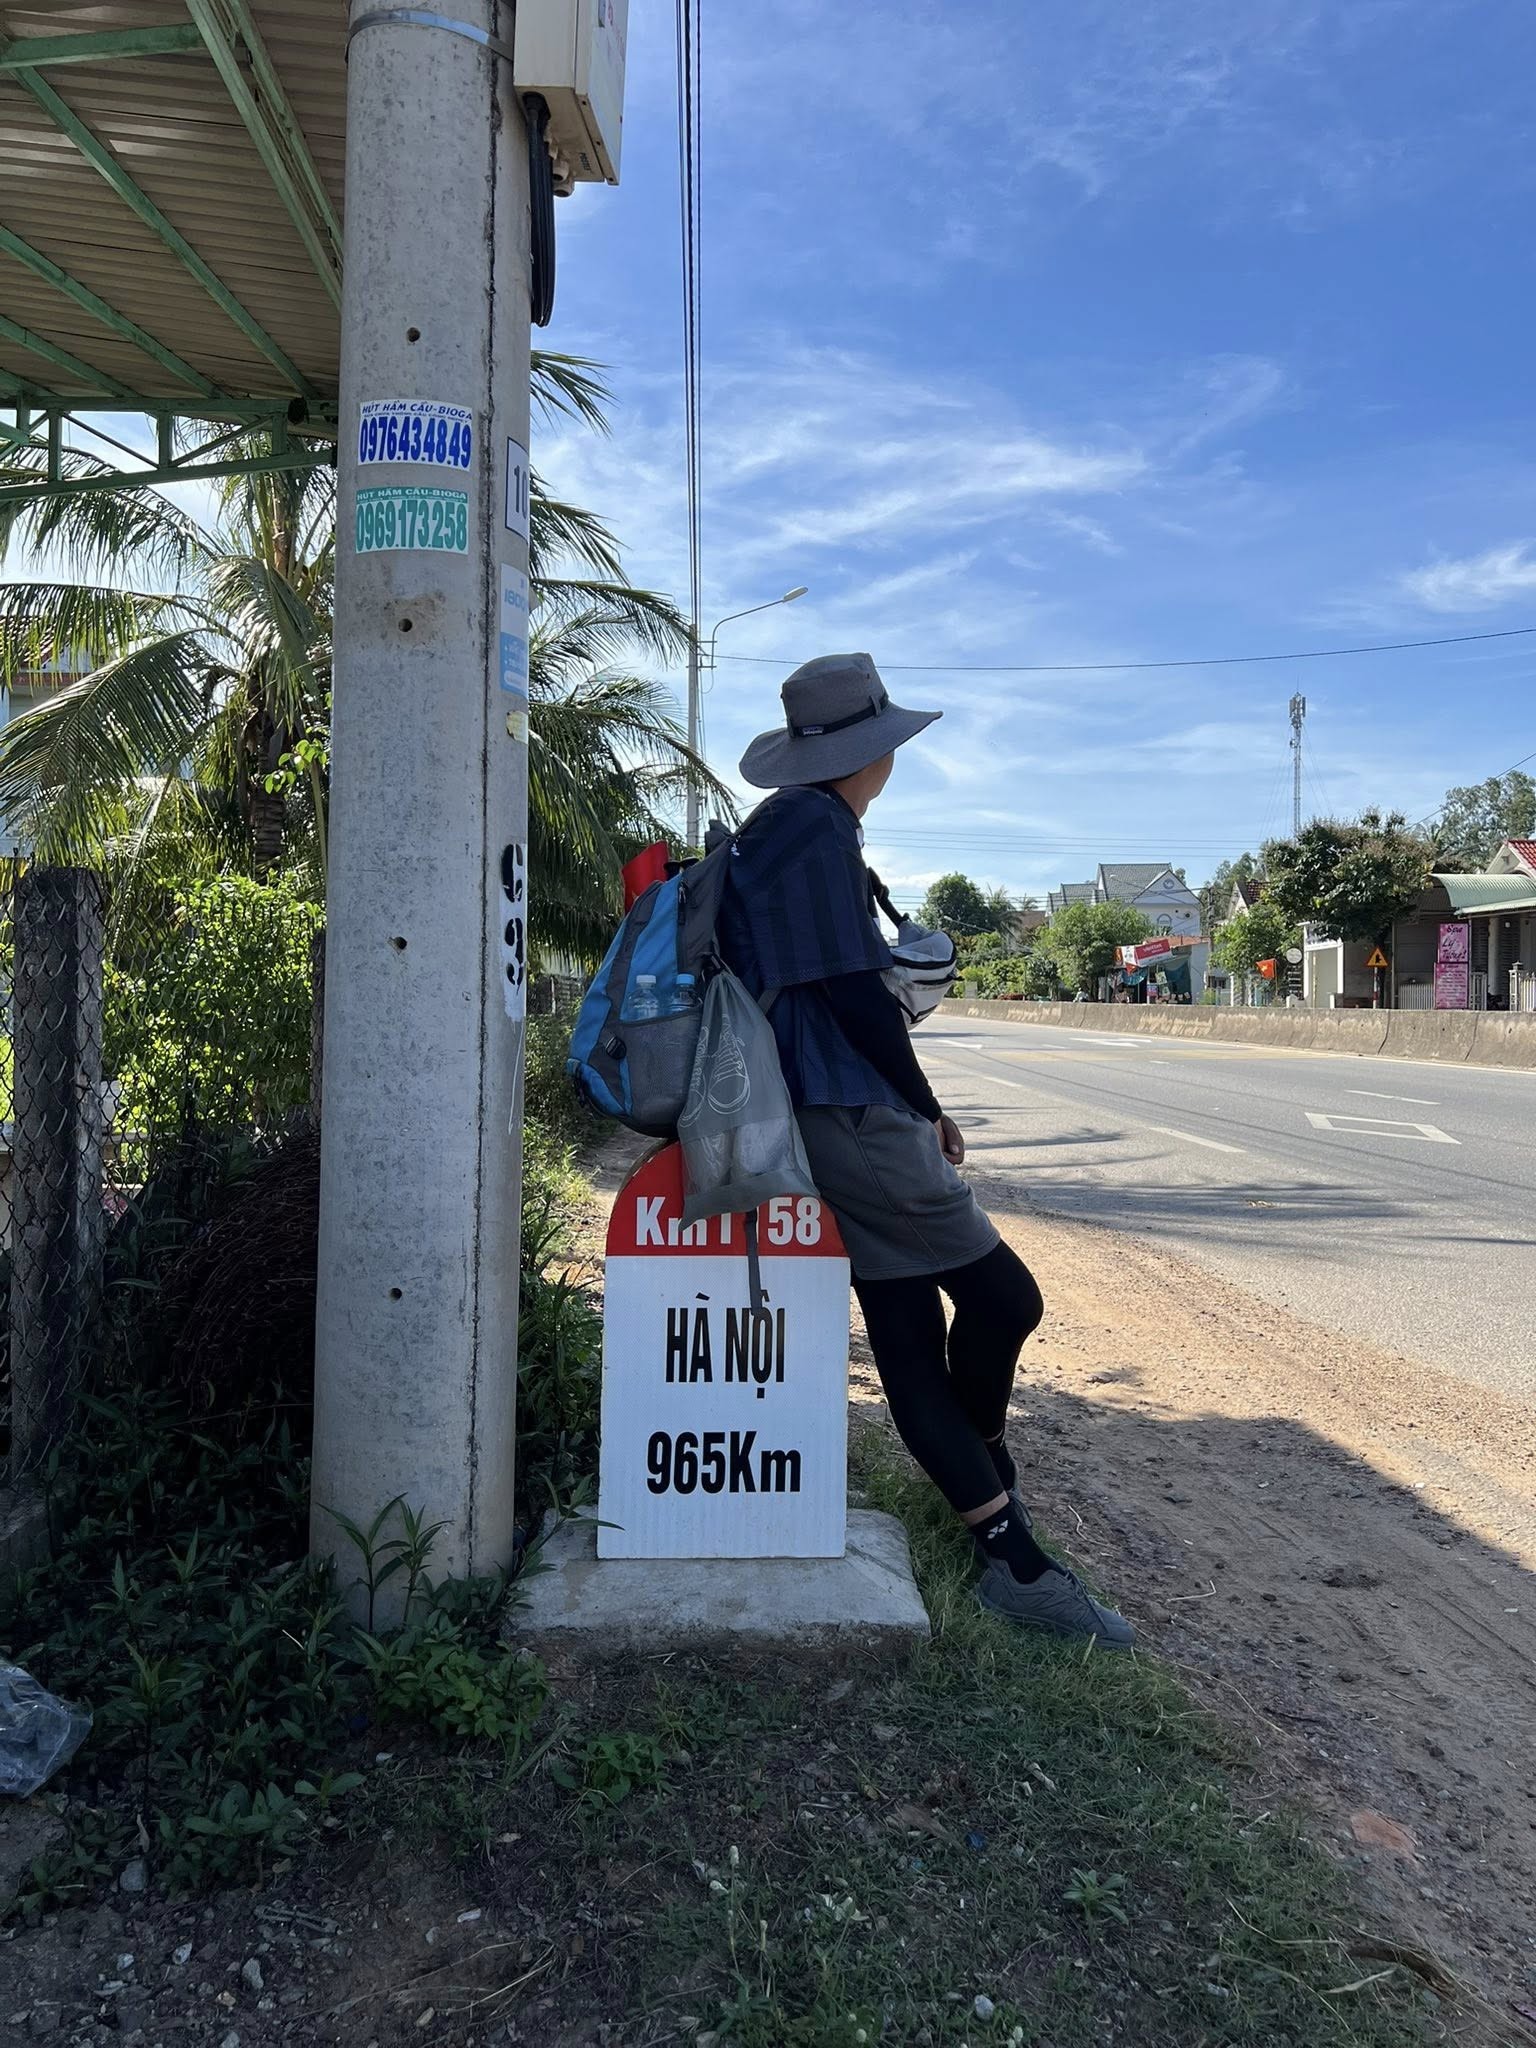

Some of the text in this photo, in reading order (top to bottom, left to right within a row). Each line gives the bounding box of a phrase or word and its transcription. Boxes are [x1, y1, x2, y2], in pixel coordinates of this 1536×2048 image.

[359, 416, 472, 469] 0976.43.48.49
[356, 499, 467, 552] 0969.173.258
[635, 1196, 821, 1246] Km158
[665, 1289, 786, 1399] HÀ NỘI
[646, 1430, 802, 1495] 965Km
